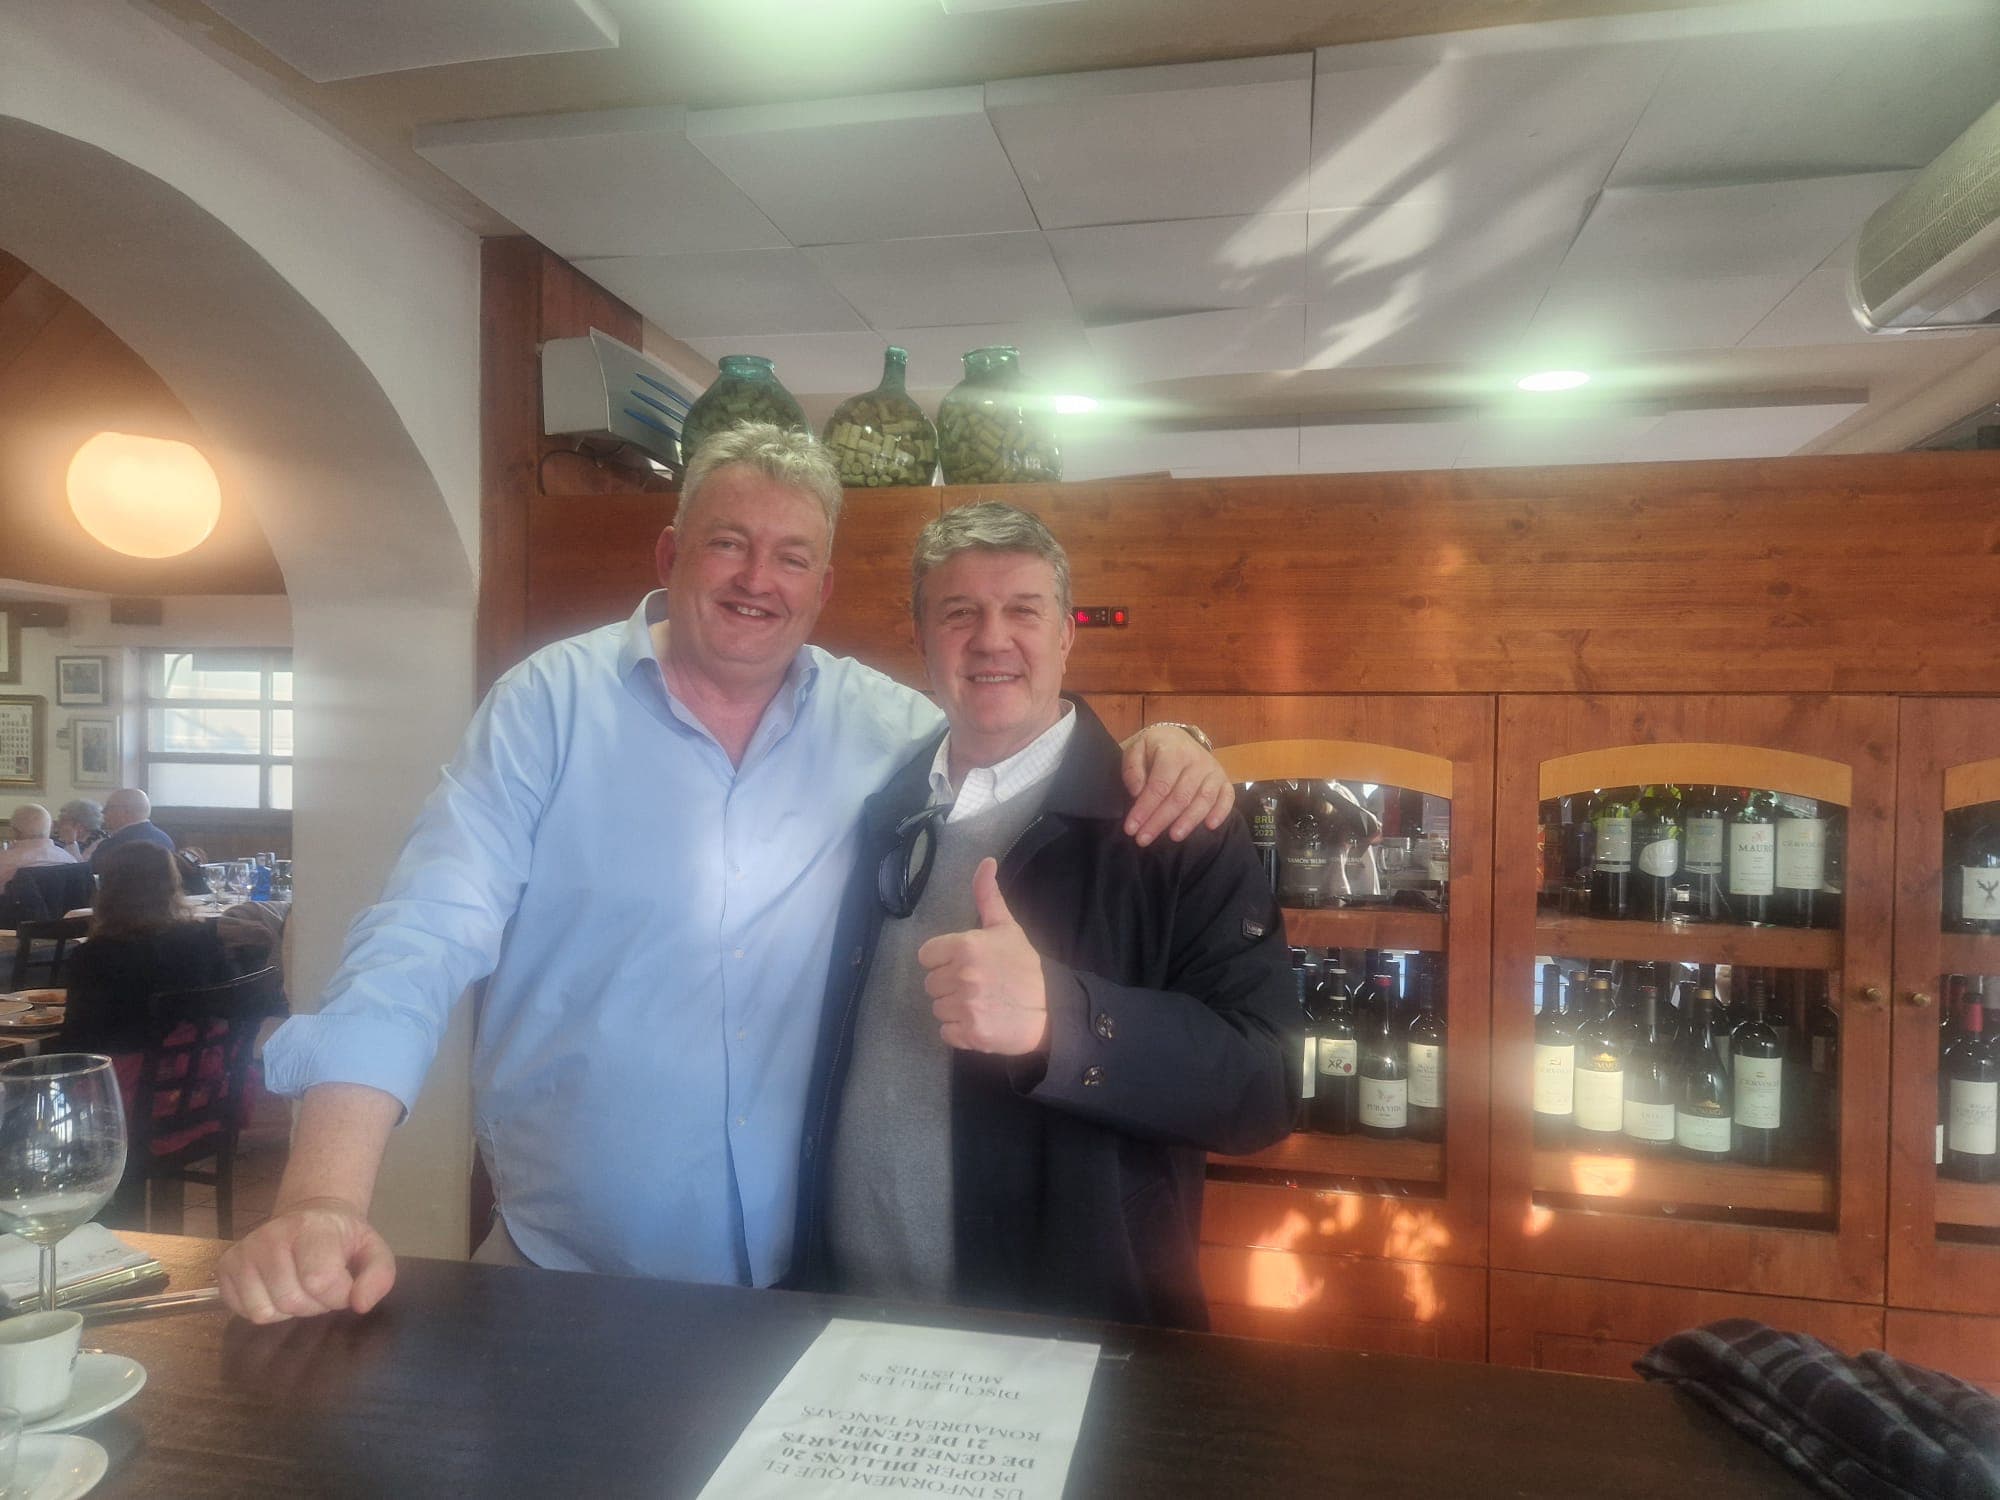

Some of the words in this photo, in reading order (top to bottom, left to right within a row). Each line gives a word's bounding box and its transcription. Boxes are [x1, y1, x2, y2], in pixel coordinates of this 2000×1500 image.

[1254, 815, 1275, 824] BRU
[1327, 1059, 1342, 1070] XR
[857, 1373, 896, 1385] LES
[886, 1364, 1004, 1385] MOLESTIES
[901, 1378, 1023, 1400] DISCULPEU
[800, 1406, 897, 1426] TANCATS
[840, 1424, 921, 1443] GENER
[905, 1418, 1041, 1442] ROMADREM
[781, 1431, 889, 1455] DIMARTS
[928, 1434, 959, 1448] DE
[967, 1437, 988, 1450] 21
[781, 1446, 806, 1460] 20
[811, 1452, 918, 1472] DILLUNS
[911, 1447, 996, 1466] GENER
[1001, 1455, 1035, 1469] DE
[794, 1466, 846, 1480] QUE
[926, 1463, 1017, 1483] PROPER
[851, 1471, 985, 1499] INFORMEM
[992, 1487, 1024, 1500] US
